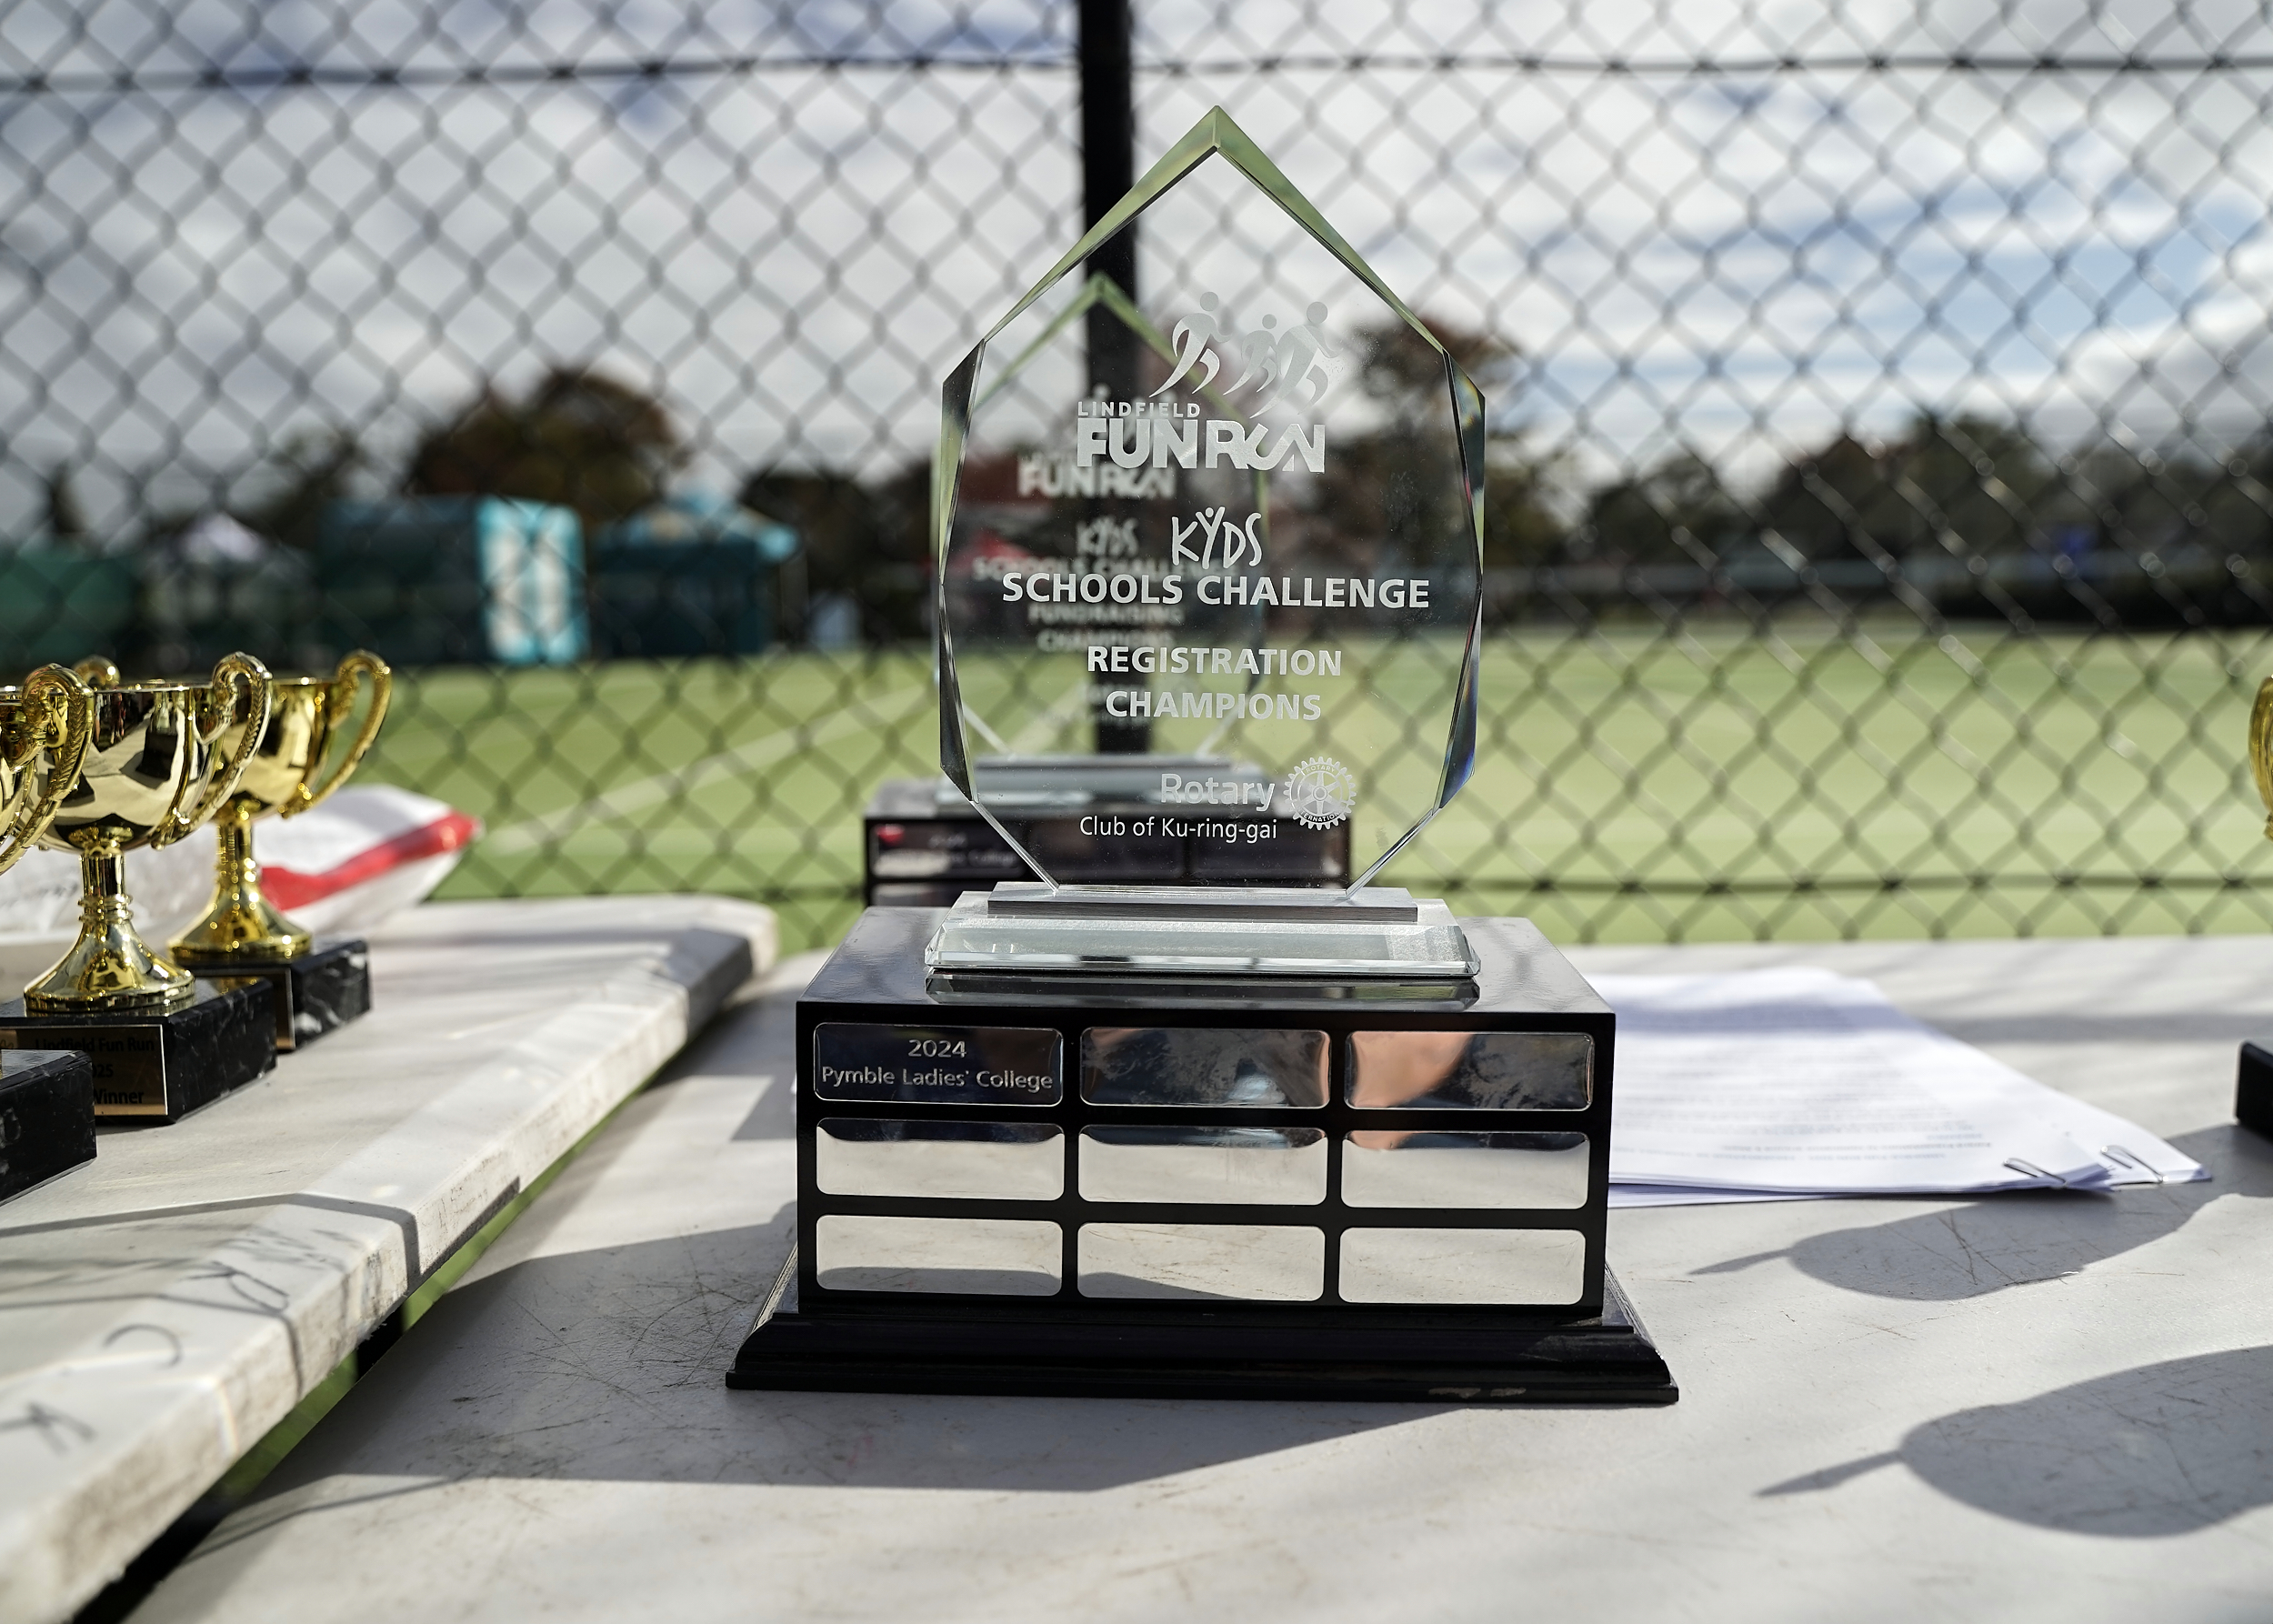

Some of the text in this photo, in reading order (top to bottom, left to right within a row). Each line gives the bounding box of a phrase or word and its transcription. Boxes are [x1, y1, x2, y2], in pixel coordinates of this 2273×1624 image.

[1077, 401, 1200, 417] LINDFIELD
[1076, 417, 1326, 472] FUN RUN
[1171, 506, 1261, 569] KYDS
[1002, 572, 1429, 608] SCHOOLS CHALLENGE
[1087, 646, 1342, 676] REGISTRATION
[1106, 690, 1321, 720] CHAMPIONS
[1306, 765, 1337, 774] ROTARY
[1160, 773, 1275, 811] Rotary
[1079, 817, 1277, 843] Club of Ku-ring-gai
[35, 1038, 155, 1052] Lindfield Fun Run
[908, 1039, 967, 1058] 2024
[822, 1066, 1053, 1093] Pymble Ladies' College
